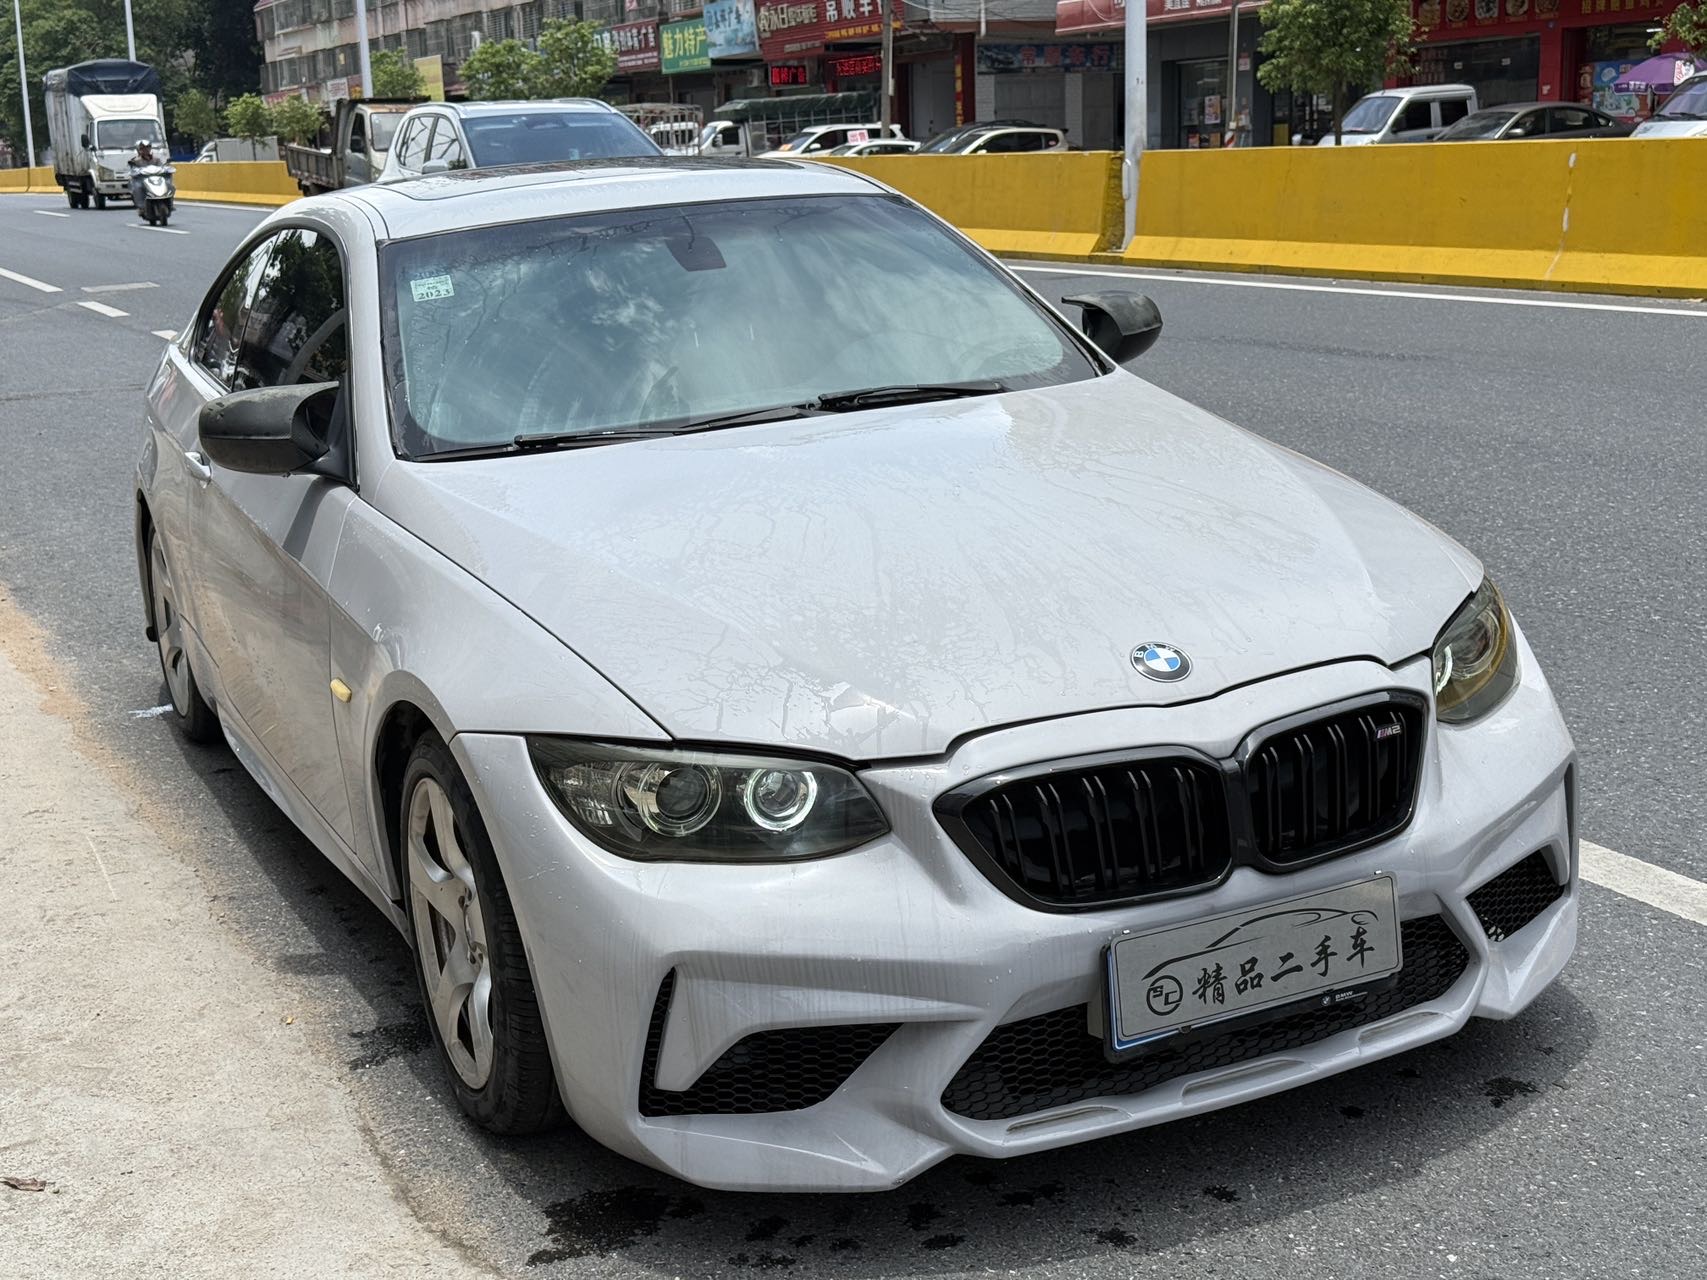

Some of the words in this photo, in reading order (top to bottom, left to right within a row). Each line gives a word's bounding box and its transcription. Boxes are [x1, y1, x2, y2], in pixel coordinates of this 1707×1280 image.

[662, 24, 706, 58] 魅力特产
[417, 289, 450, 299] 2023
[1191, 926, 1375, 1005] 精品二手车
